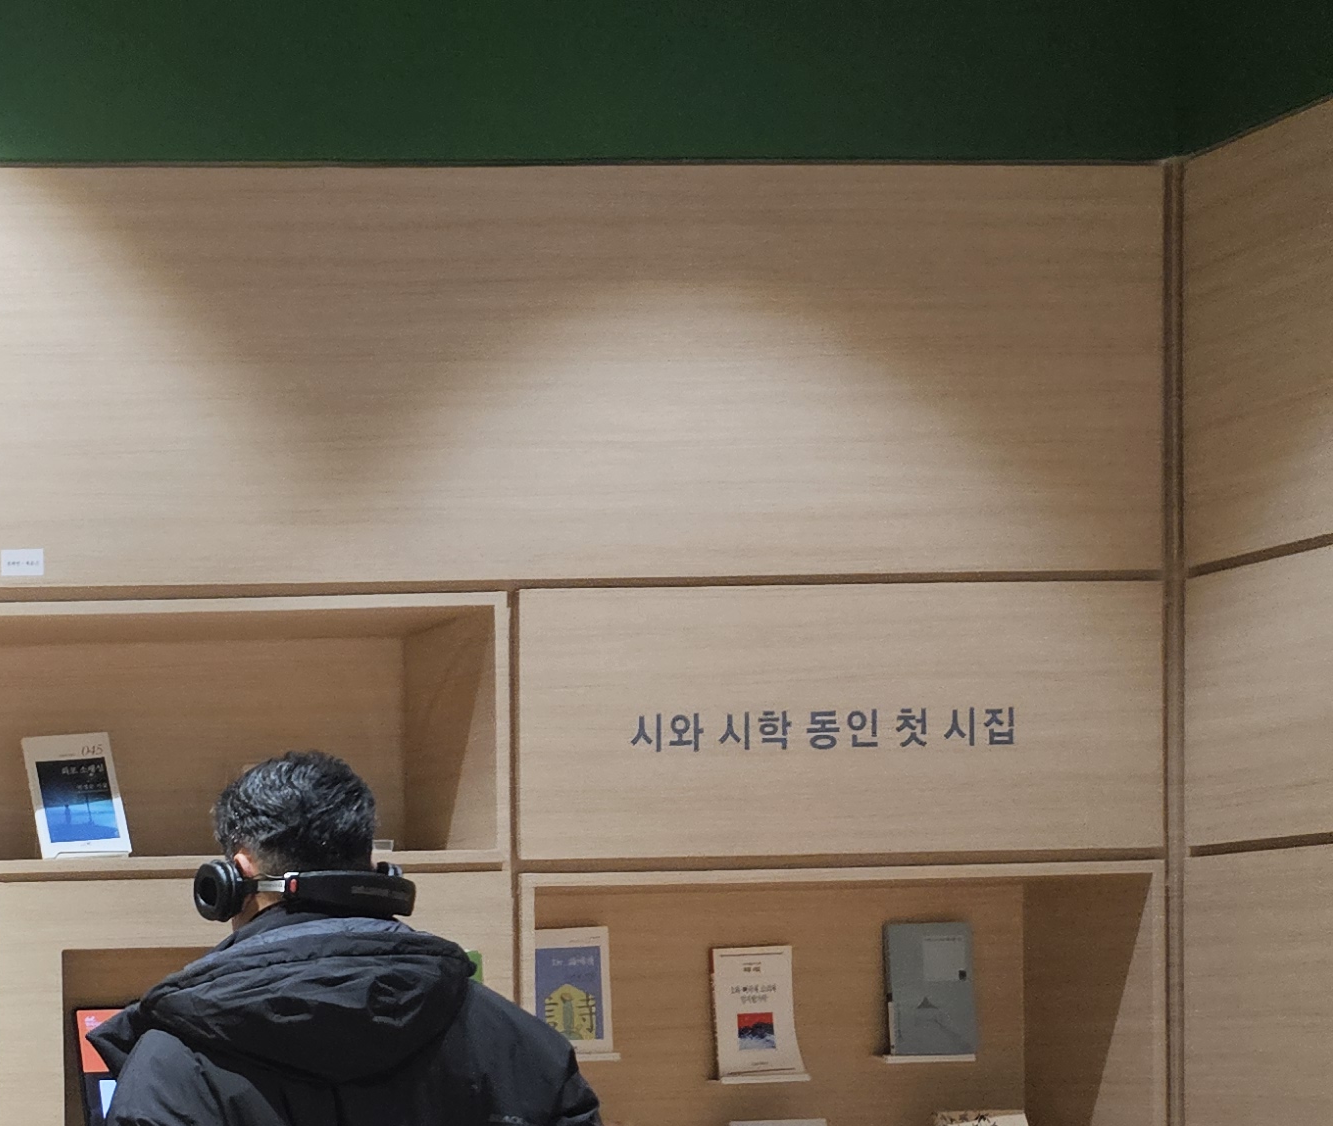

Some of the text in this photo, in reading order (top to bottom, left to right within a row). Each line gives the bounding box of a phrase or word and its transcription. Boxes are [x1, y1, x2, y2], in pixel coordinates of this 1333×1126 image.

[630, 706, 1016, 753] 시와 시학 동인 첫 시집
